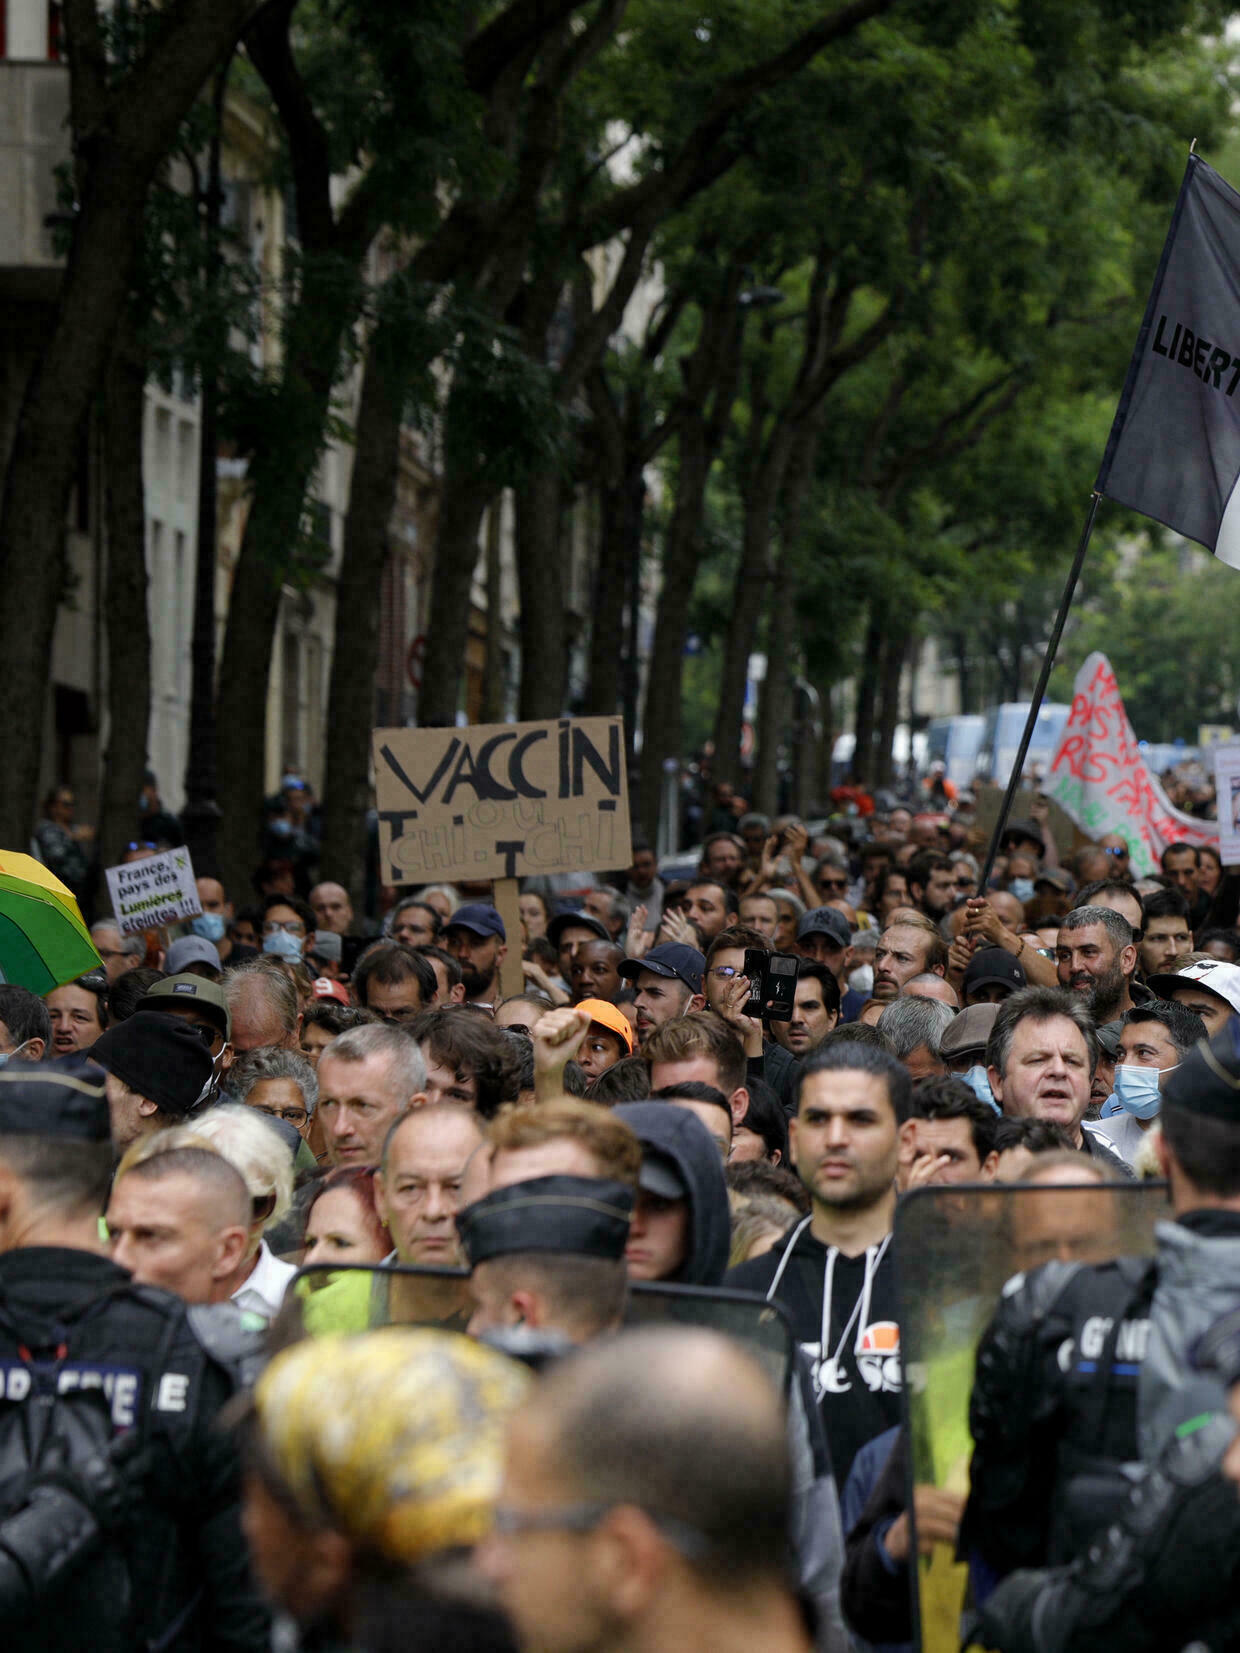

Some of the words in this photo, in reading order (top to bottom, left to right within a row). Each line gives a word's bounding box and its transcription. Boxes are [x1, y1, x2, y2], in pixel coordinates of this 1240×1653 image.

[118, 862, 171, 883] France,
[117, 881, 150, 900] pays
[154, 871, 178, 887] des
